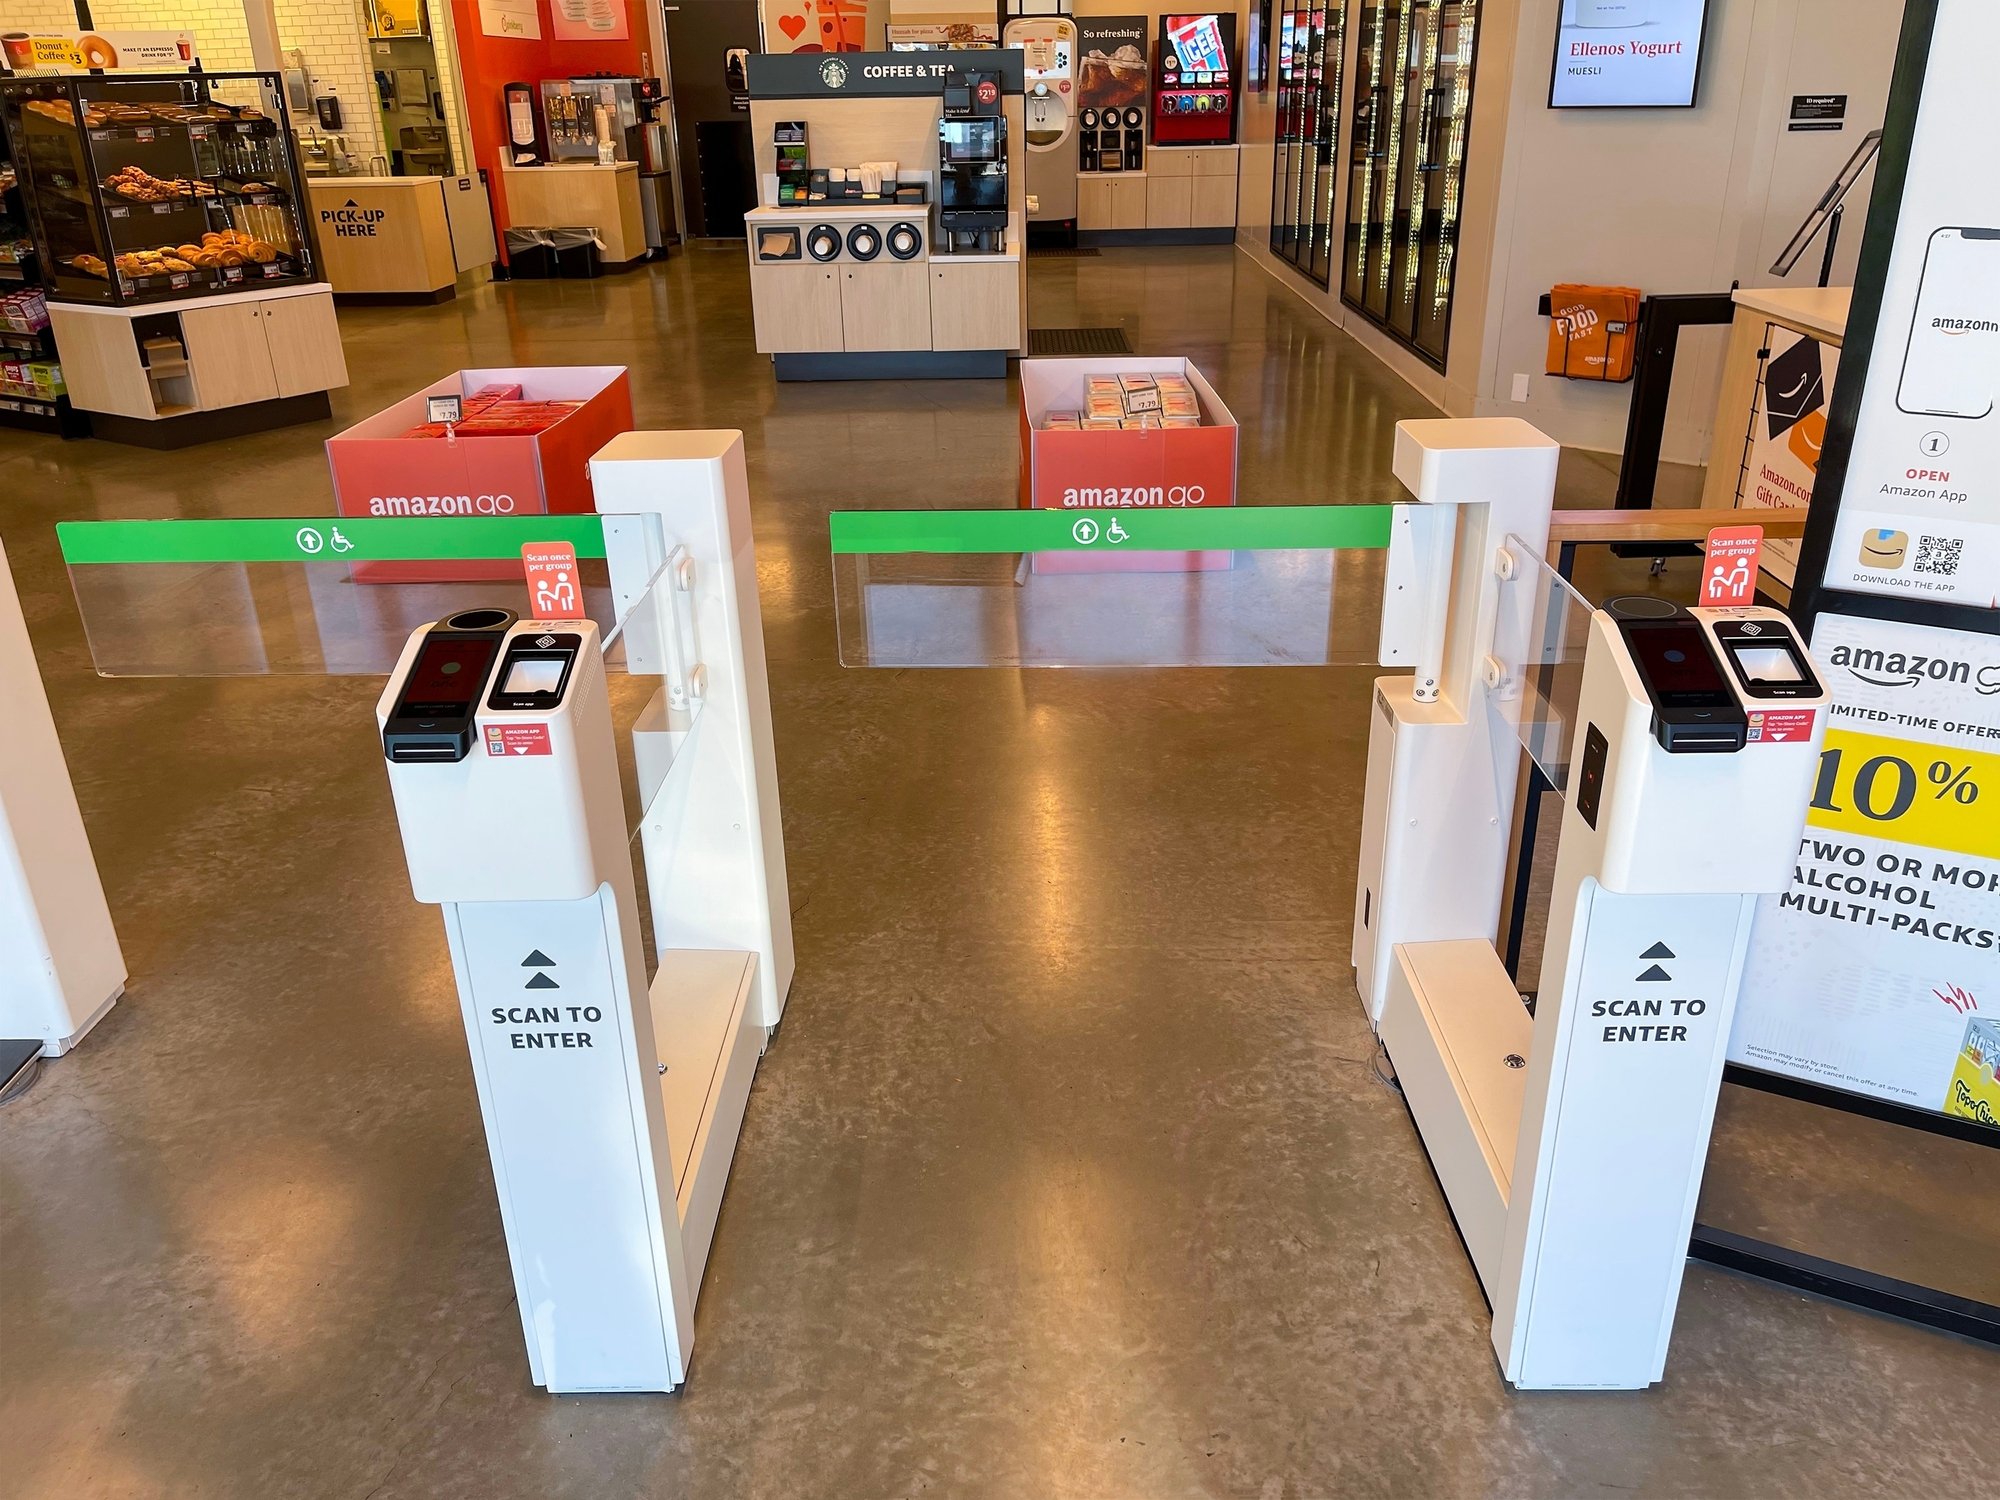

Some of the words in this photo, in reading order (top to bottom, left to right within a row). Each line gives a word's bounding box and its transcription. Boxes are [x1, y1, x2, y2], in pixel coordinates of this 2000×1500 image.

[1084, 30, 1094, 38] So
[1096, 29, 1140, 39] refreshing
[35, 42, 63, 50] Donut
[1180, 32, 1218, 66] ICEE
[1570, 42, 1625, 56] Ellenos
[1630, 40, 1682, 58] Yogurt
[38, 52, 65, 60] Coffee
[863, 66, 914, 78] COFFEE
[916, 64, 926, 77] &
[1568, 67, 1601, 75] MUESLI
[321, 210, 385, 223] PICK-UP
[336, 224, 376, 236] HERE
[1560, 304, 1585, 315] GOOD
[1556, 309, 1598, 336] FOOD
[1569, 328, 1592, 341] FAST
[1929, 438, 1938, 451] 1
[1906, 468, 1950, 482] OPEN
[1063, 486, 1164, 507] amazon
[1168, 486, 1205, 507] go
[1757, 486, 1772, 506] Gift
[1880, 484, 1935, 498] Amazon
[1939, 490, 1967, 503] App
[370, 495, 472, 516] amazon
[476, 494, 514, 515] go
[1711, 549, 1726, 557] per
[1728, 548, 1755, 556] group
[546, 563, 572, 571] group
[1853, 574, 1911, 587] DOWNLOAD
[1914, 581, 1933, 590] THE
[1935, 584, 1955, 592] APP
[1830, 645, 1970, 684] amazon
[1830, 704, 1938, 729] IMITED-TIME
[1799, 838, 1865, 866] TWO
[1876, 854, 1922, 878] OR
[1793, 866, 1936, 909] ALCOHOL
[491, 1007, 560, 1024] SCAN
[566, 1006, 602, 1022] TO
[1592, 1000, 1662, 1016] SCAN
[1670, 1000, 1706, 1016] TO
[510, 1032, 593, 1049] ENTER
[1602, 1026, 1687, 1042] ENTER
[1747, 1044, 1777, 1056] Selection
[1779, 1052, 1793, 1061] may
[1820, 1063, 1839, 1071] store.
[1746, 1051, 1772, 1061] Amazon
[1774, 1057, 1788, 1065] may
[1789, 1061, 1813, 1072] modify
[1823, 1069, 1845, 1079] cancel
[1860, 1078, 1877, 1086] offer
[1902, 1088, 1919, 1096] time.
[1956, 1079, 1976, 1111] Topo
